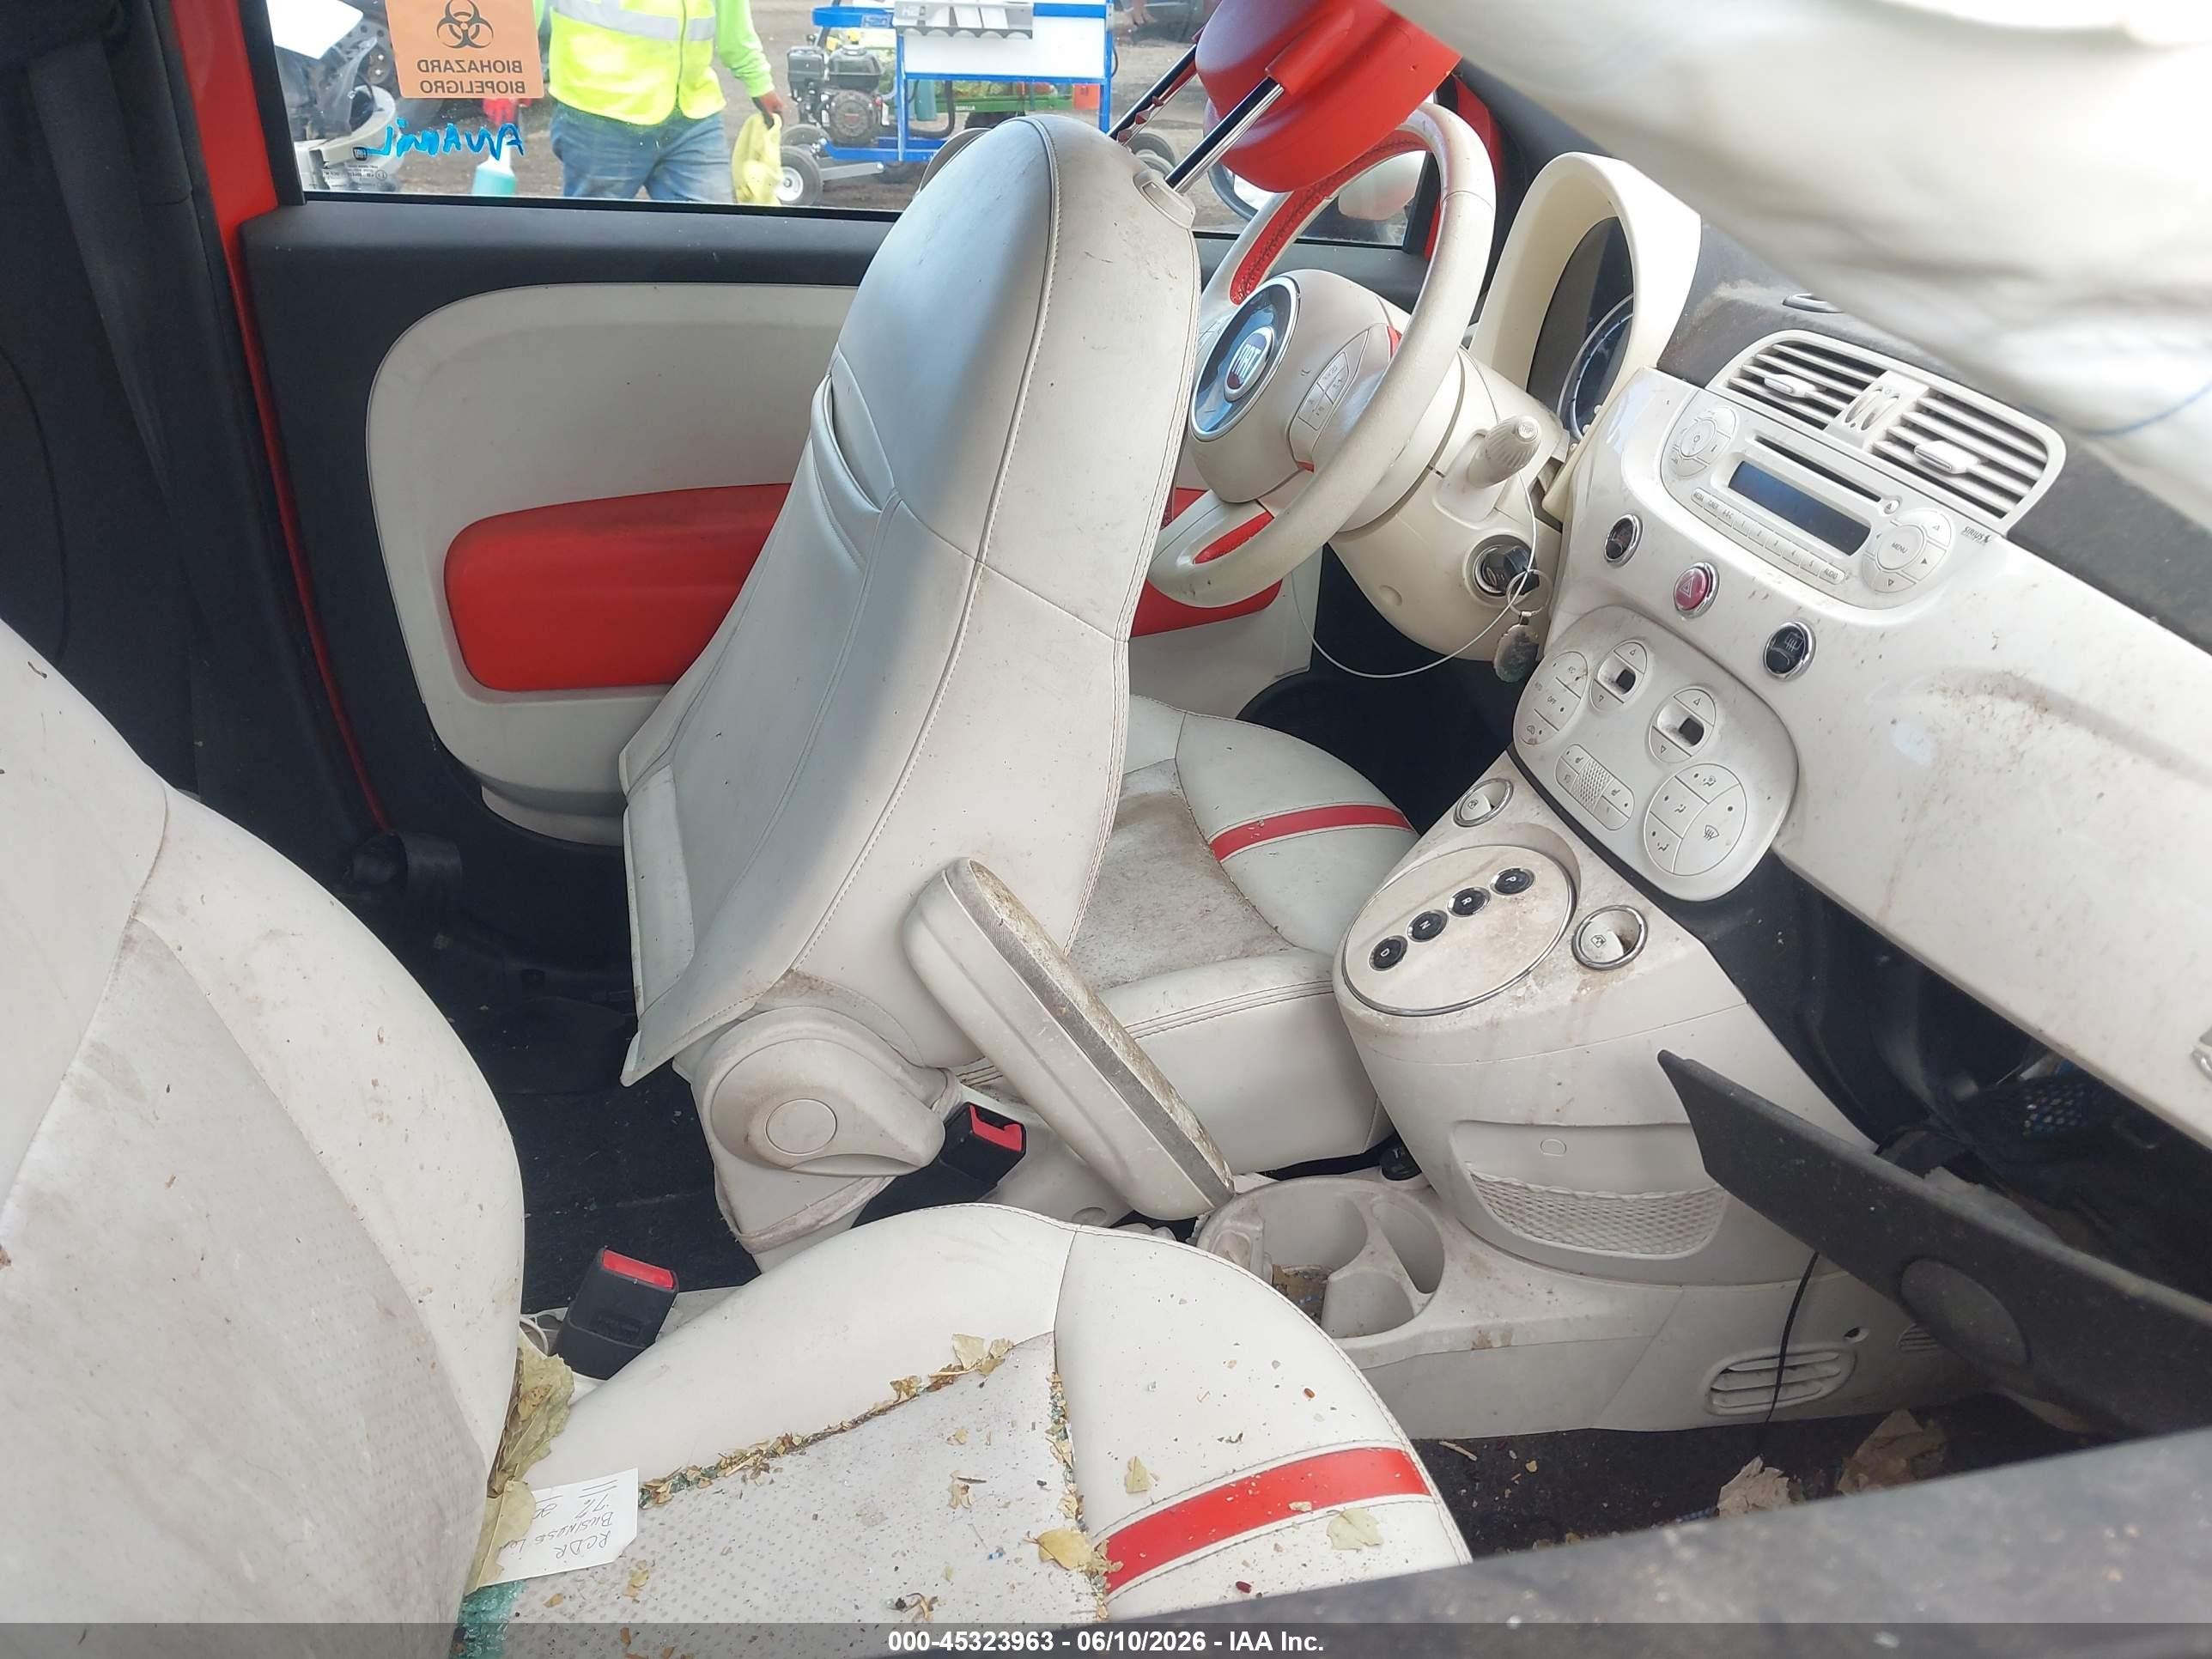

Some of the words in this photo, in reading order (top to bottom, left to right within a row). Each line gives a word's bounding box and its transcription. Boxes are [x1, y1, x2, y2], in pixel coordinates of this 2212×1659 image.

[1231, 343, 1262, 380] FIAT
[1892, 542, 1908, 554] MENU
[1824, 568, 1839, 580] AUDIO
[1462, 896, 1472, 906] R
[1419, 920, 1431, 930] N
[1380, 948, 1390, 957] D
